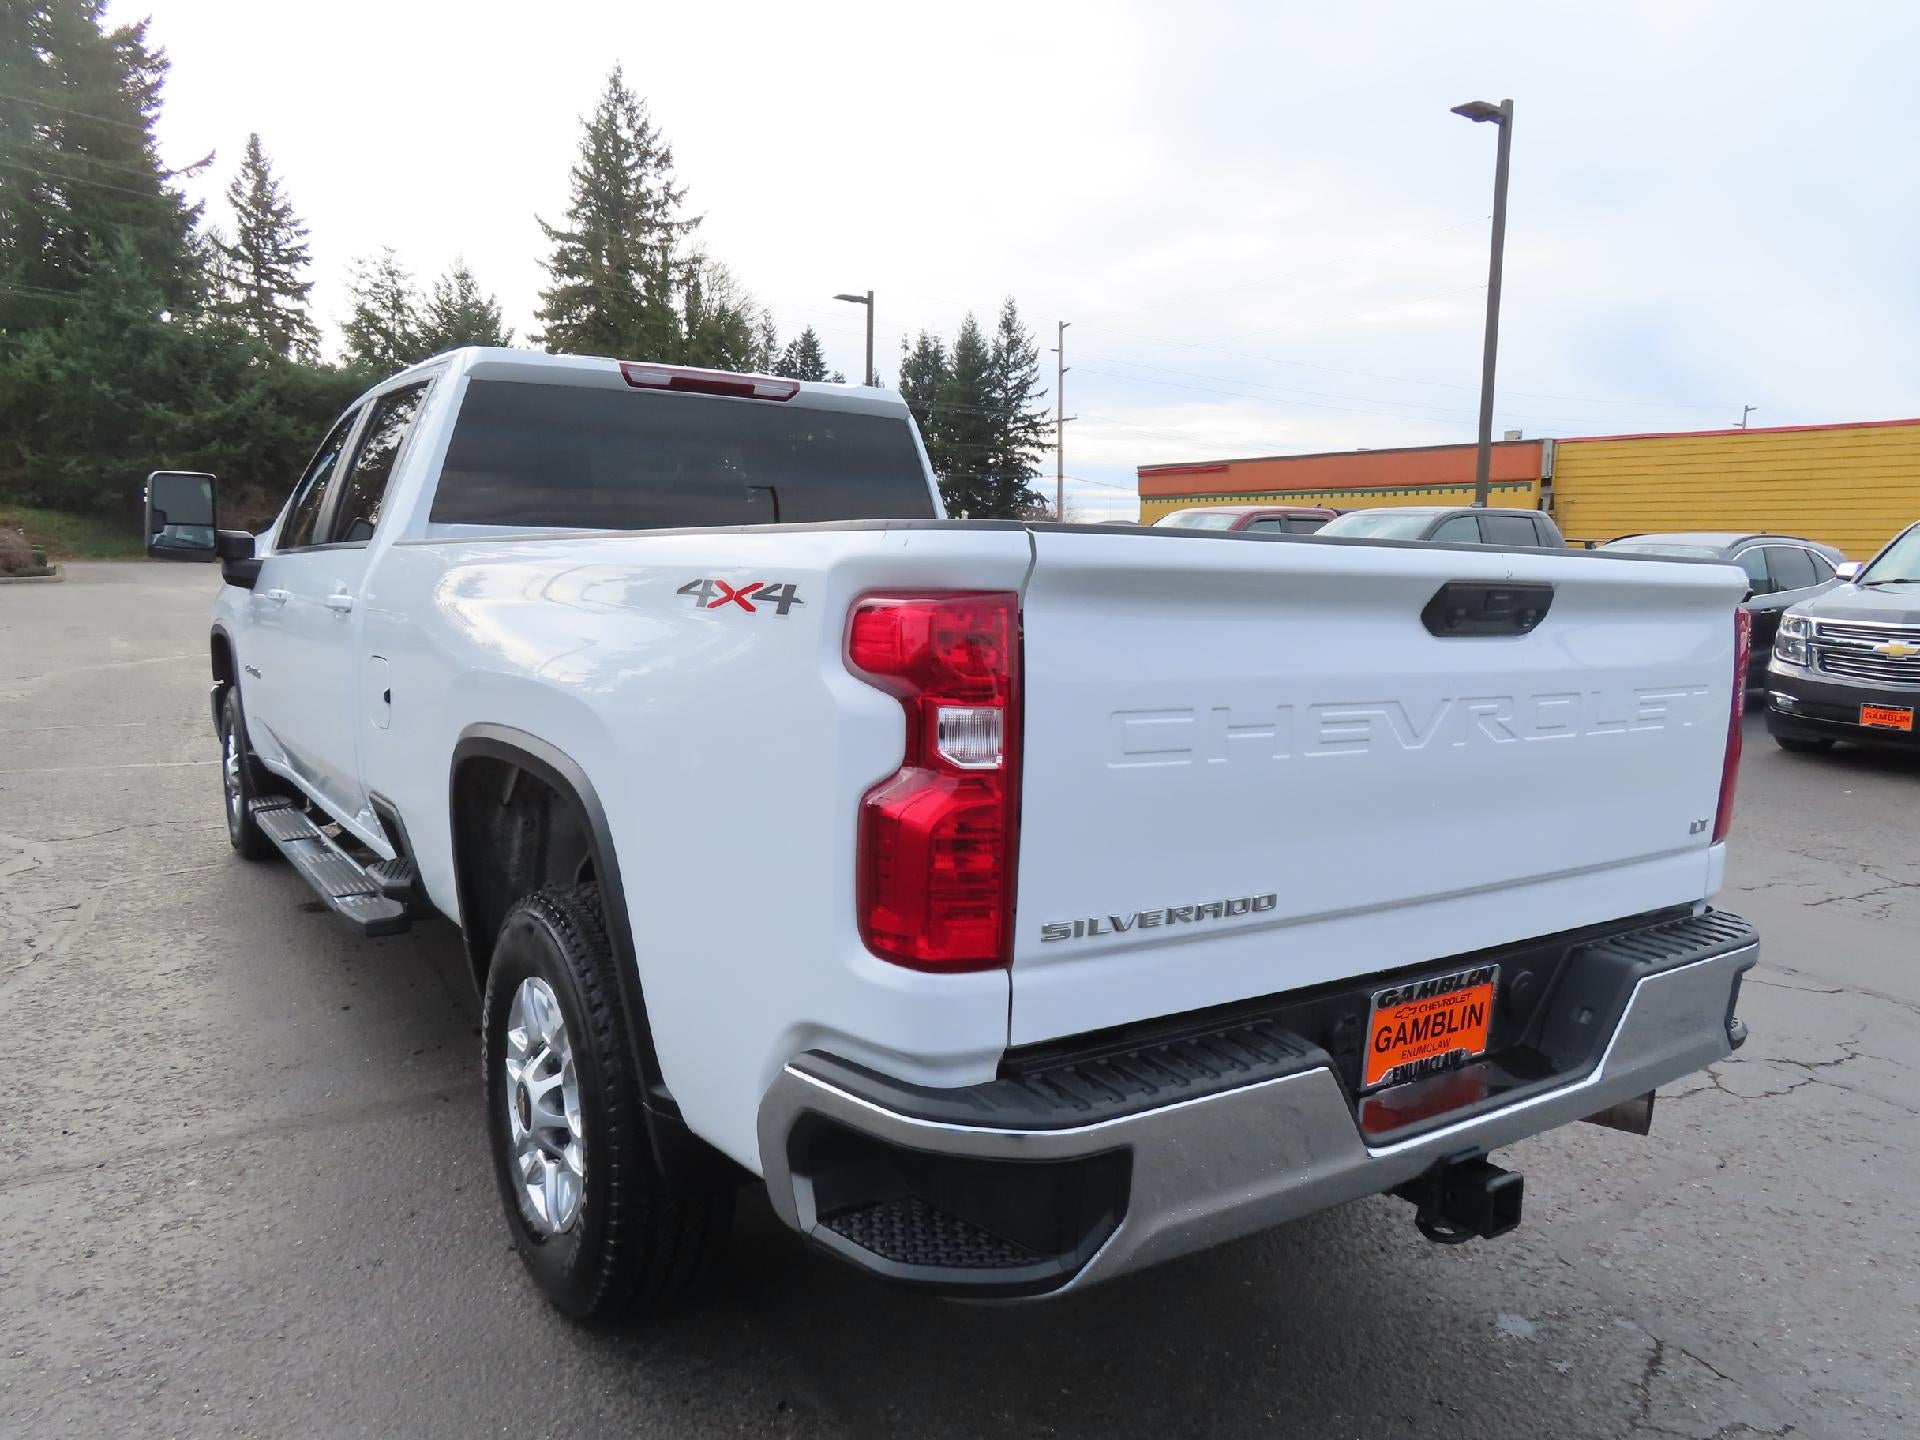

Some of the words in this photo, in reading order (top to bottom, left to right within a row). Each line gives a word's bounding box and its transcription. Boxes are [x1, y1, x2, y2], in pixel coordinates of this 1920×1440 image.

[1107, 685, 1708, 768] CHEVROLET
[1865, 712, 1910, 722] GAMBLIN
[1689, 819, 1709, 834] LT
[1041, 893, 1277, 942] SILVERADO
[1418, 993, 1472, 1013] CHEVROLET
[1375, 1002, 1484, 1053] GAMBLIN
[1401, 1038, 1452, 1059] ENUMCLAW
